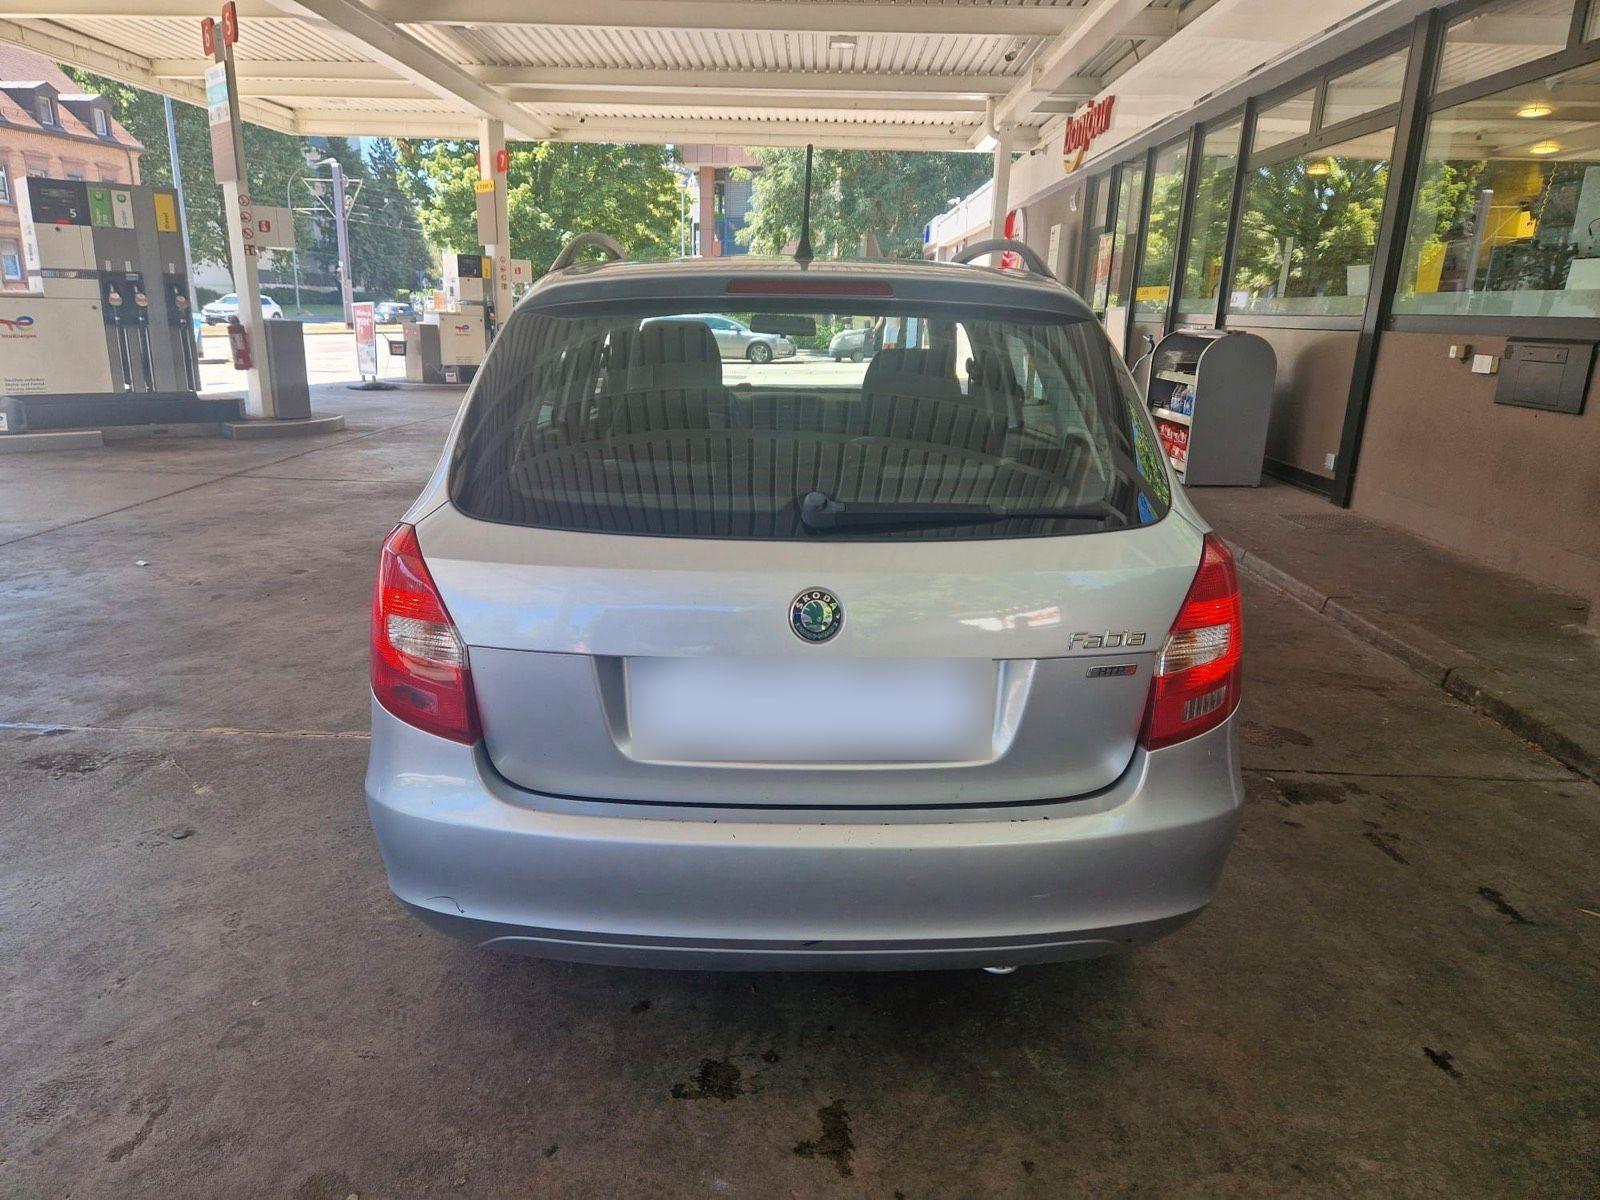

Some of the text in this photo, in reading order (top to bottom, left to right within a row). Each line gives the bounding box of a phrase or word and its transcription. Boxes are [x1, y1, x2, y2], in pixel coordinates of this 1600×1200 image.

[204, 27, 211, 46] 6
[1063, 95, 1115, 155] bonjour
[69, 208, 77, 218] 5
[1067, 630, 1146, 650] Fabia
